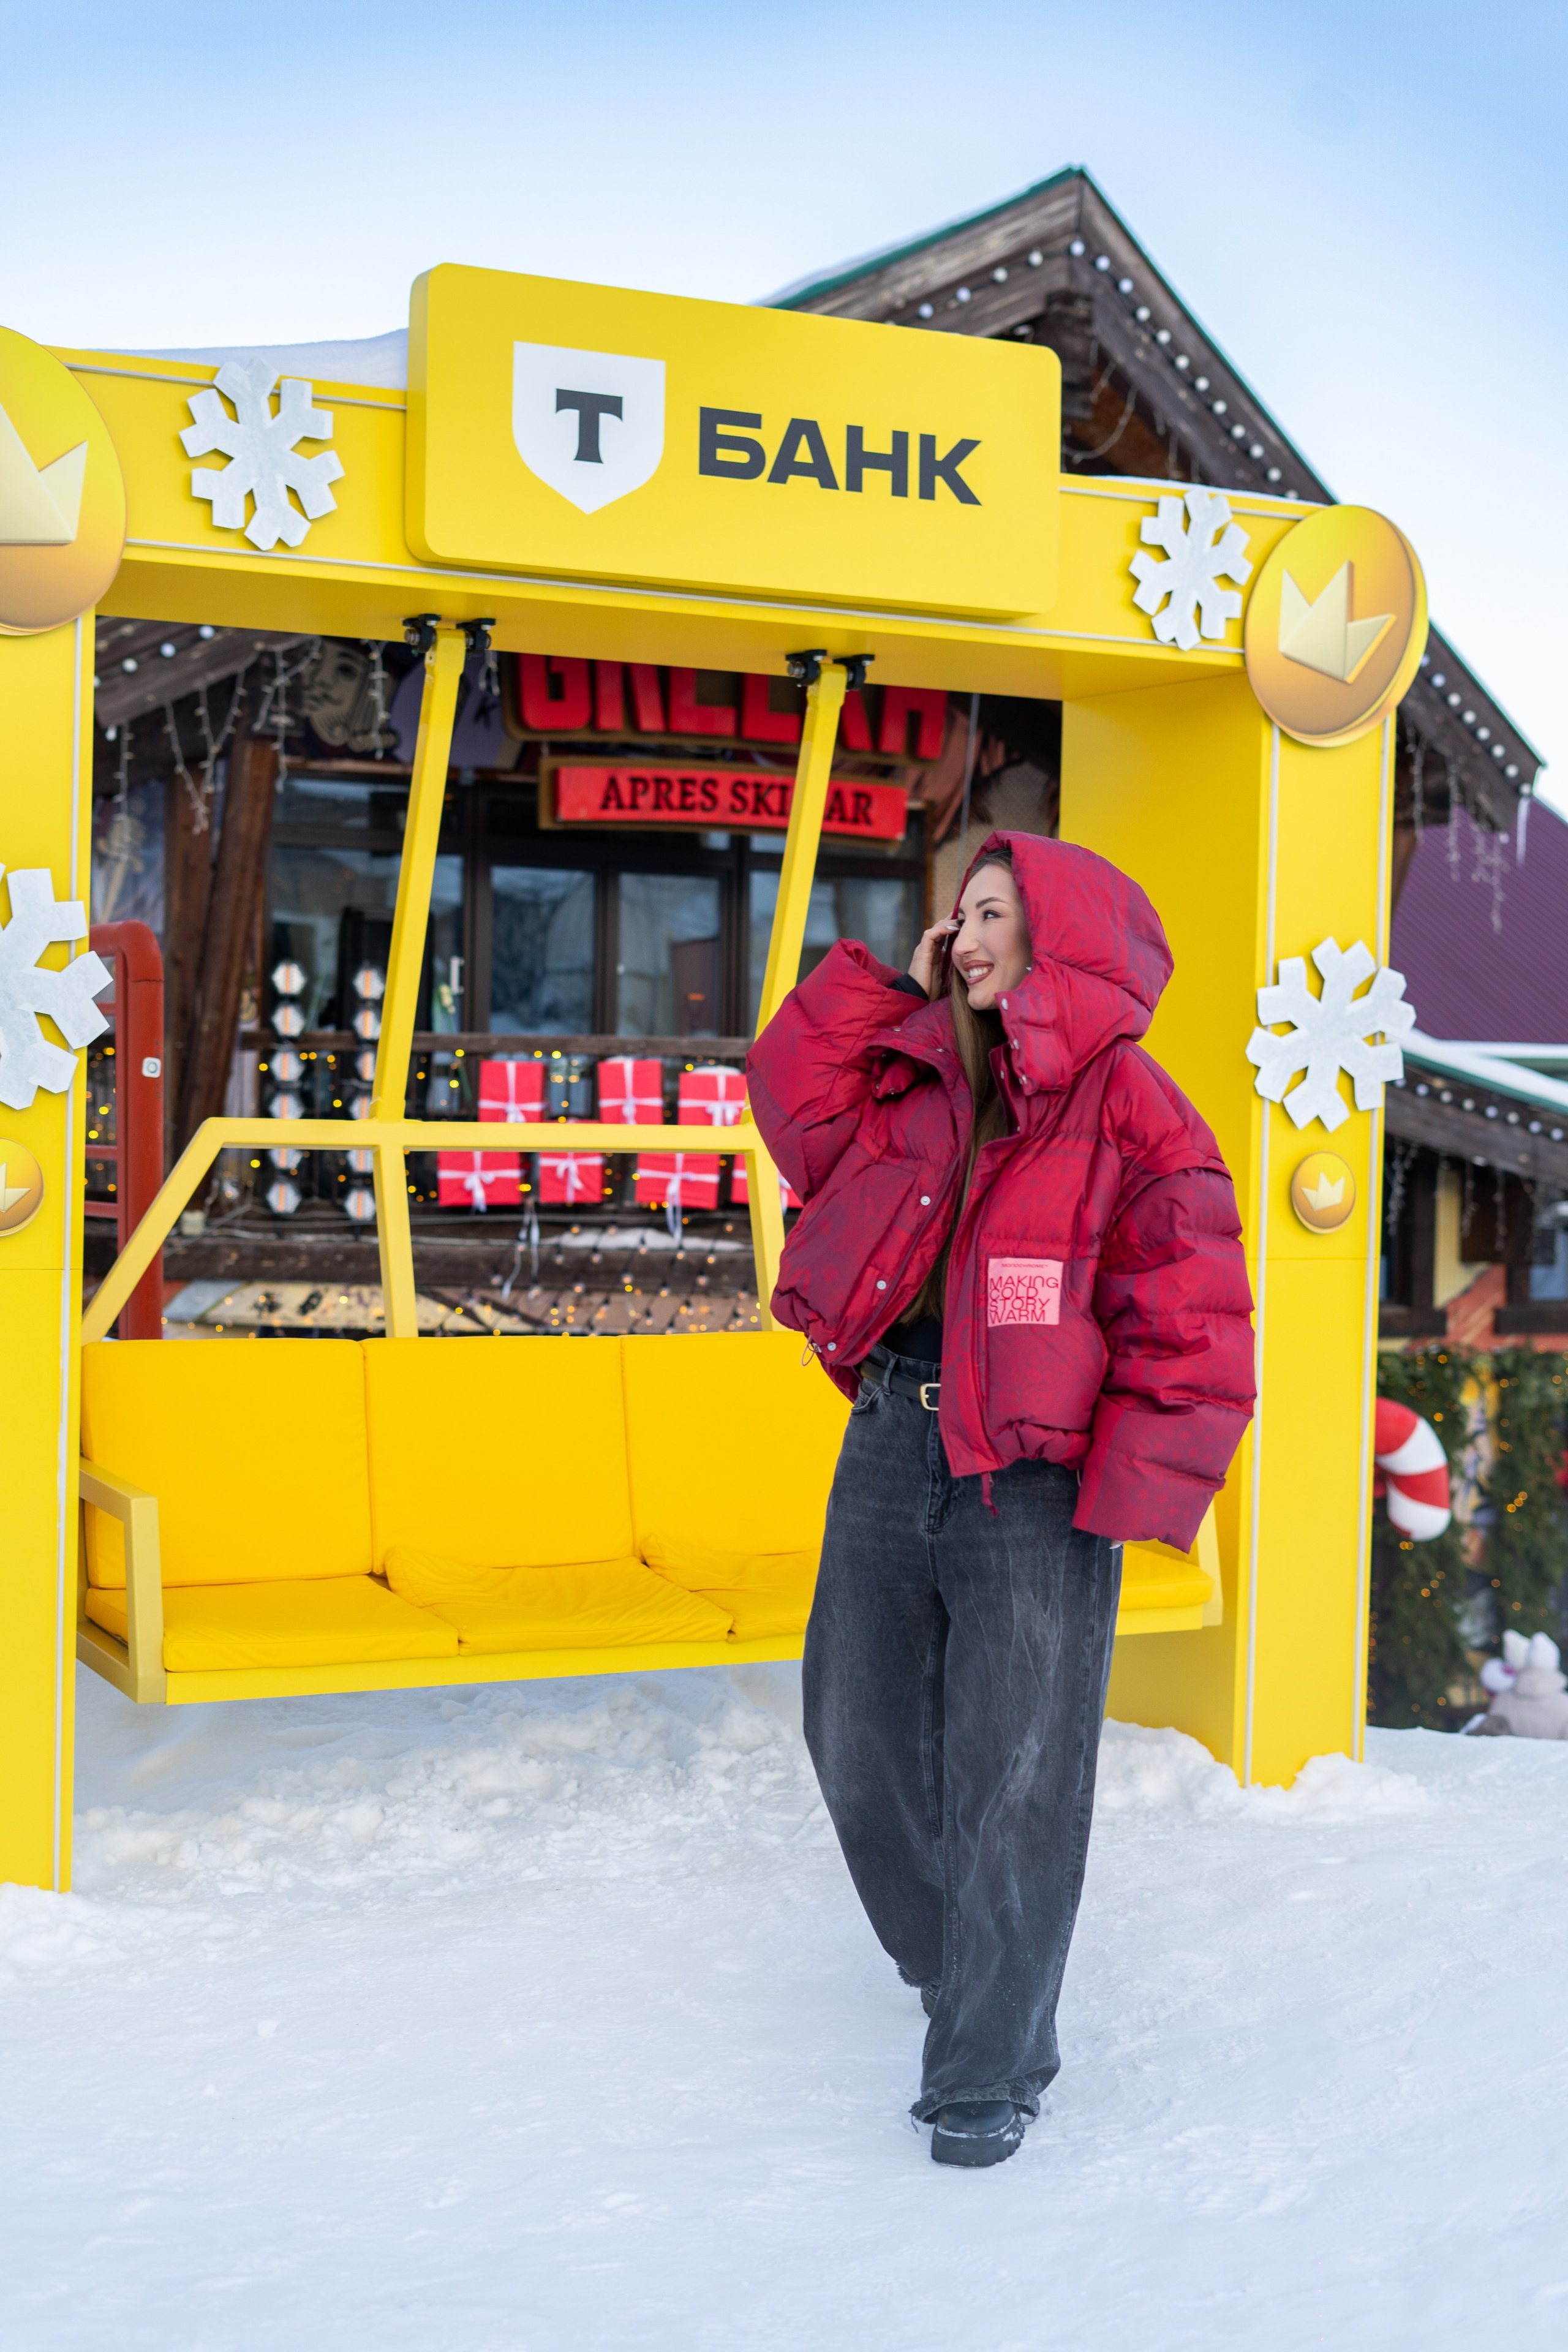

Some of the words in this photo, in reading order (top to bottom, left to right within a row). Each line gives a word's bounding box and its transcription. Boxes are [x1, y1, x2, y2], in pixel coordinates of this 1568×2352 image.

[699, 406, 982, 506] БАНК
[600, 775, 718, 813] APRES
[729, 780, 790, 816] SKI
[824, 790, 873, 826] AR
[989, 1286, 1039, 1300] COLD
[989, 1297, 1050, 1313] STORY
[989, 1310, 1046, 1324] WARM
